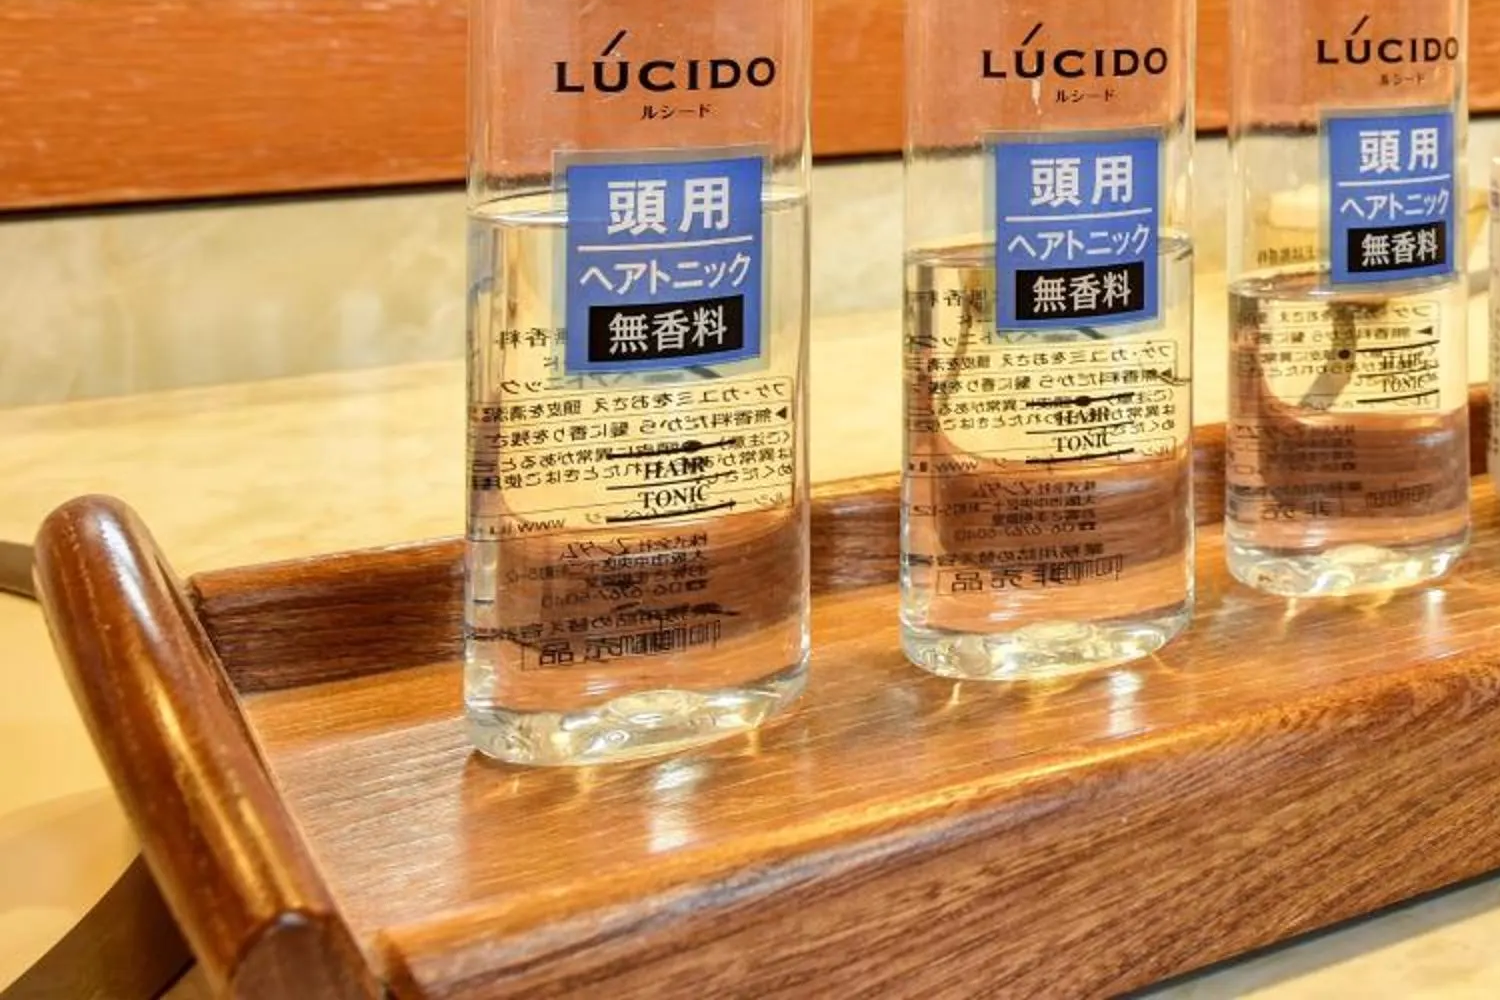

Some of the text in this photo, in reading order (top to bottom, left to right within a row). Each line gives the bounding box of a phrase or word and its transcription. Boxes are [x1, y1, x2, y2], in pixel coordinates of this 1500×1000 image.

[983, 23, 1167, 78] LÚCIDO
[1317, 15, 1459, 64] LÚCIDO
[555, 30, 775, 93] LÚCIDO
[641, 103, 713, 120] ルシード
[1056, 89, 1117, 103] ルシード
[1359, 127, 1438, 173] 頭用
[1030, 155, 1132, 207] 頭用
[608, 177, 730, 236] 頭用
[1340, 189, 1450, 221] ヘアトニック
[1007, 224, 1151, 261] ヘアトニック
[1361, 228, 1438, 266] 無香料
[579, 252, 752, 296] ヘアトニック
[1033, 270, 1132, 313] 無香料
[608, 305, 727, 355] 無香料
[644, 456, 706, 480] HAIR
[638, 484, 710, 509] TONIC
